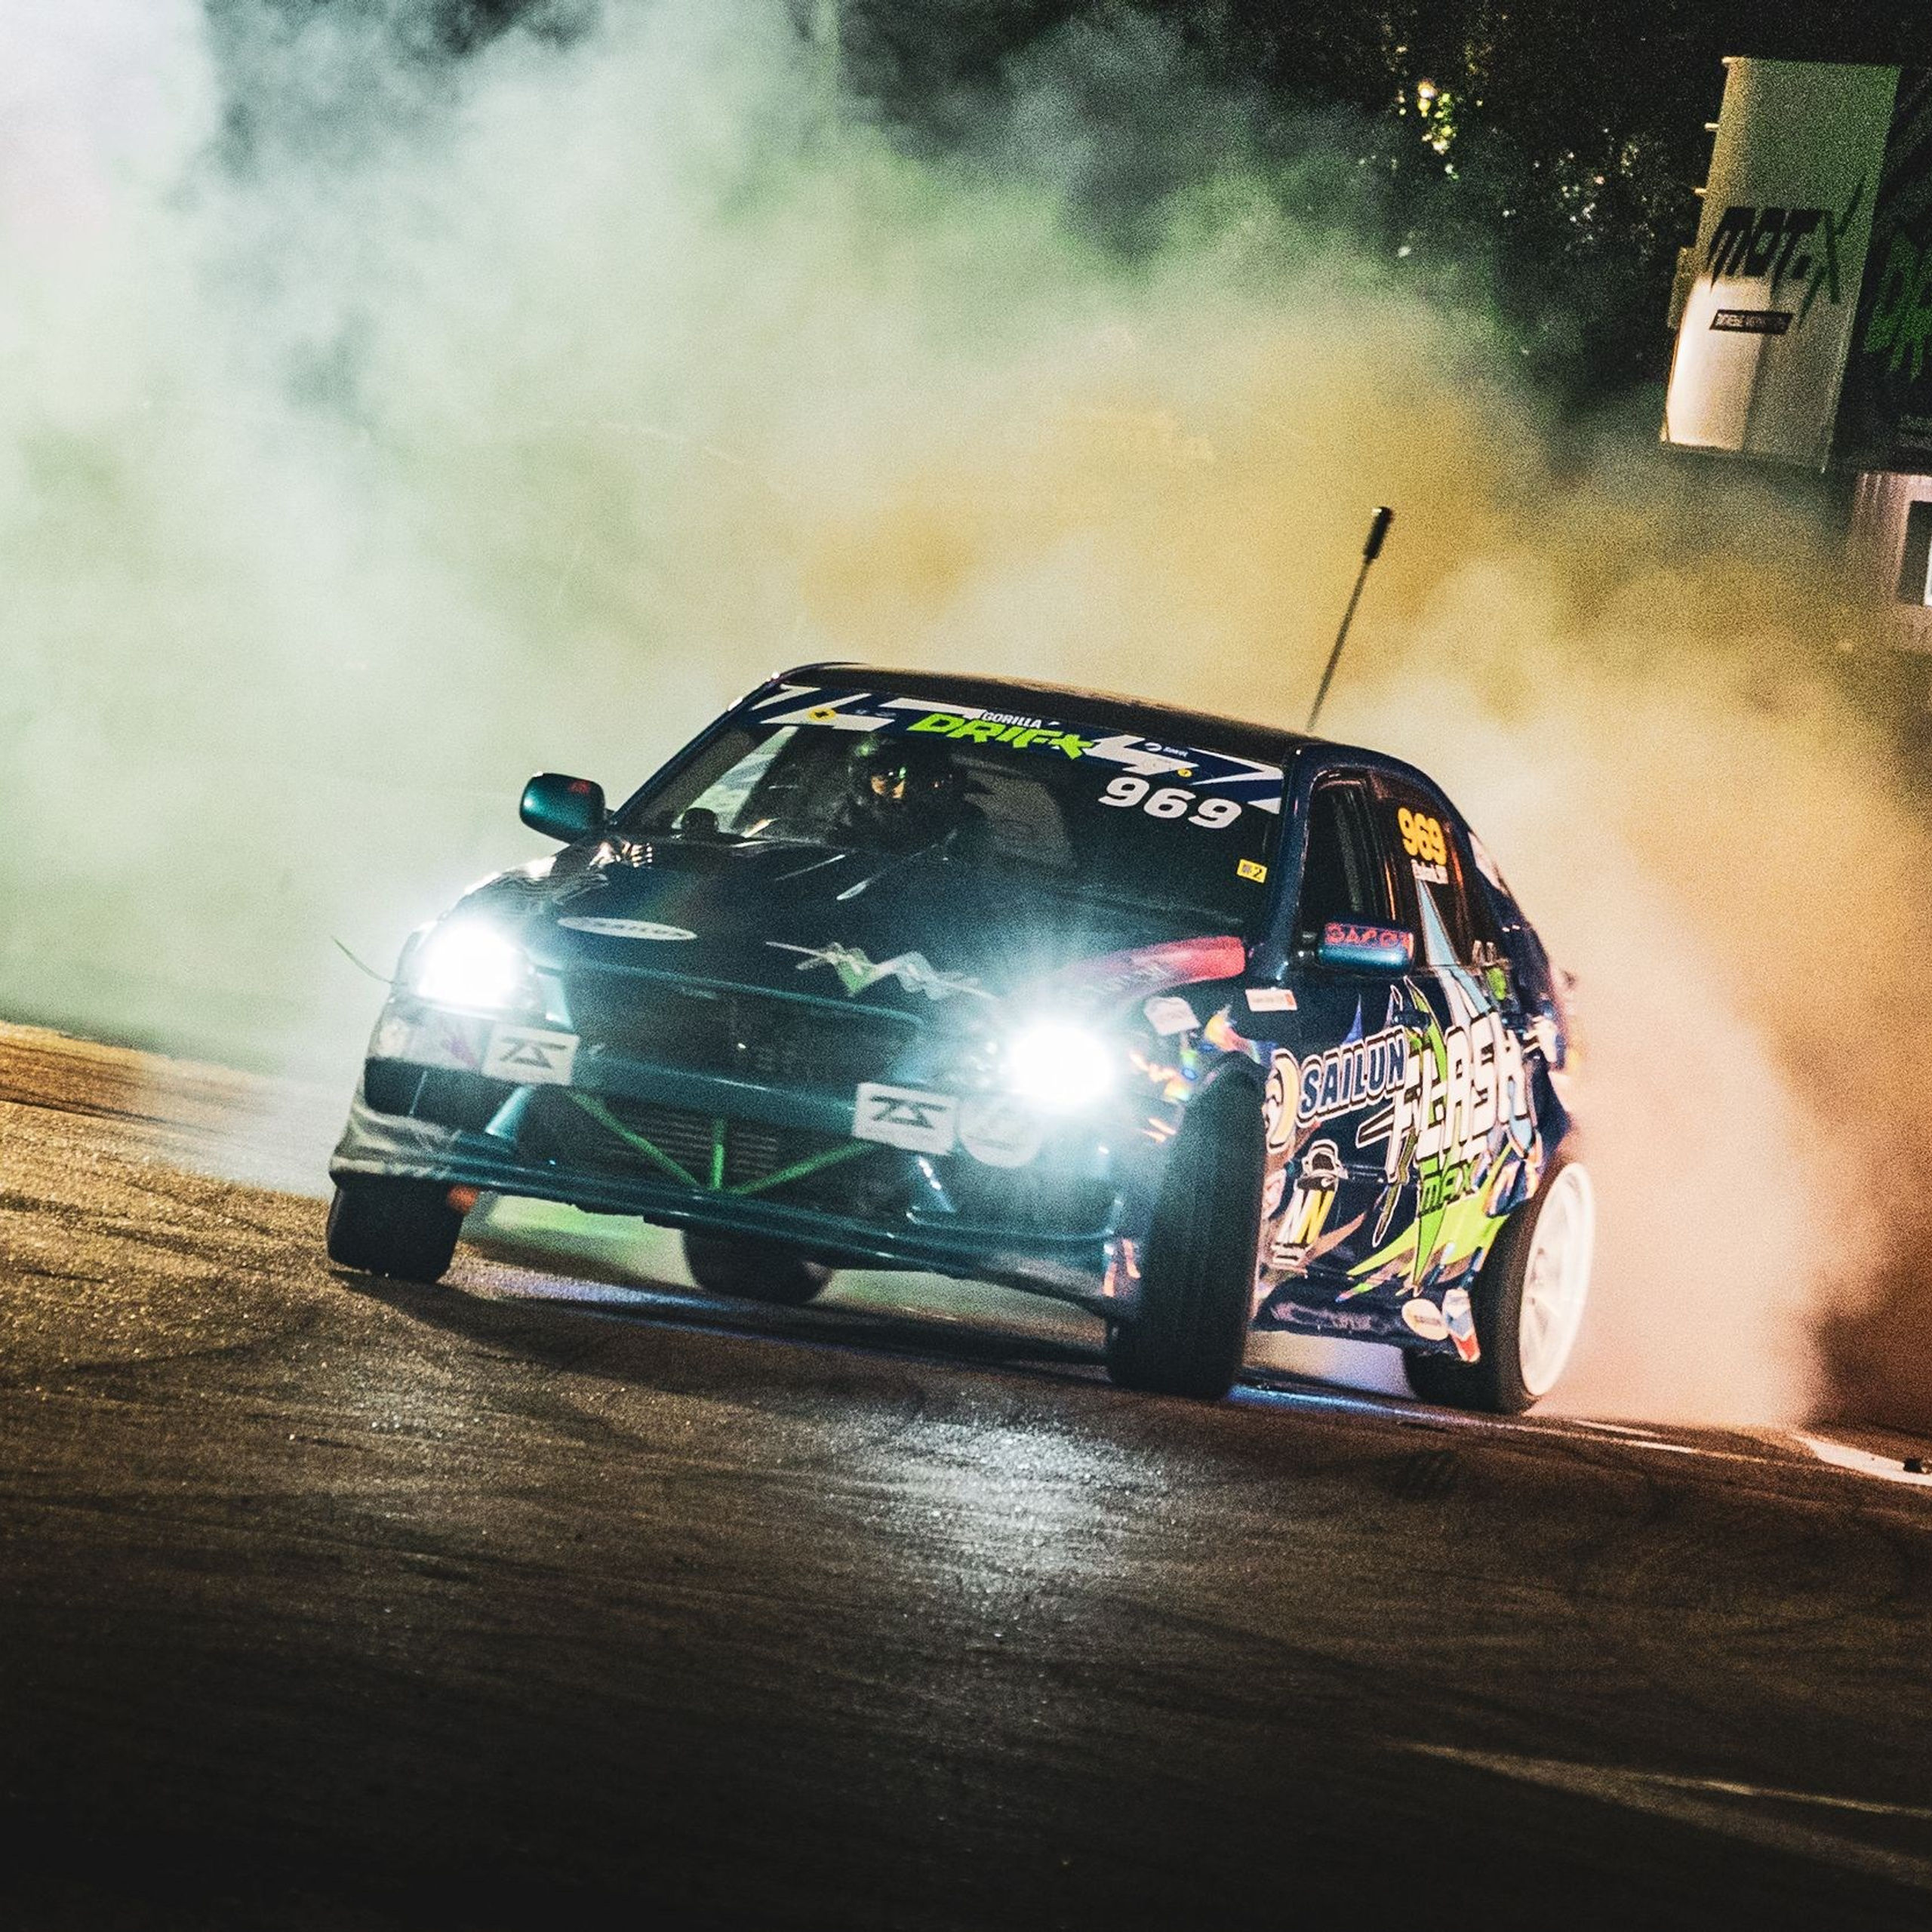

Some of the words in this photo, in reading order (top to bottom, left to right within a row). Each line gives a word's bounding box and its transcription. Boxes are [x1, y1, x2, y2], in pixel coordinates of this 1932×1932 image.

[982, 710, 1042, 729] GORILLA
[1098, 777, 1242, 829] 969
[1398, 808, 1447, 866] 969
[1298, 1033, 1407, 1118] SAILUN
